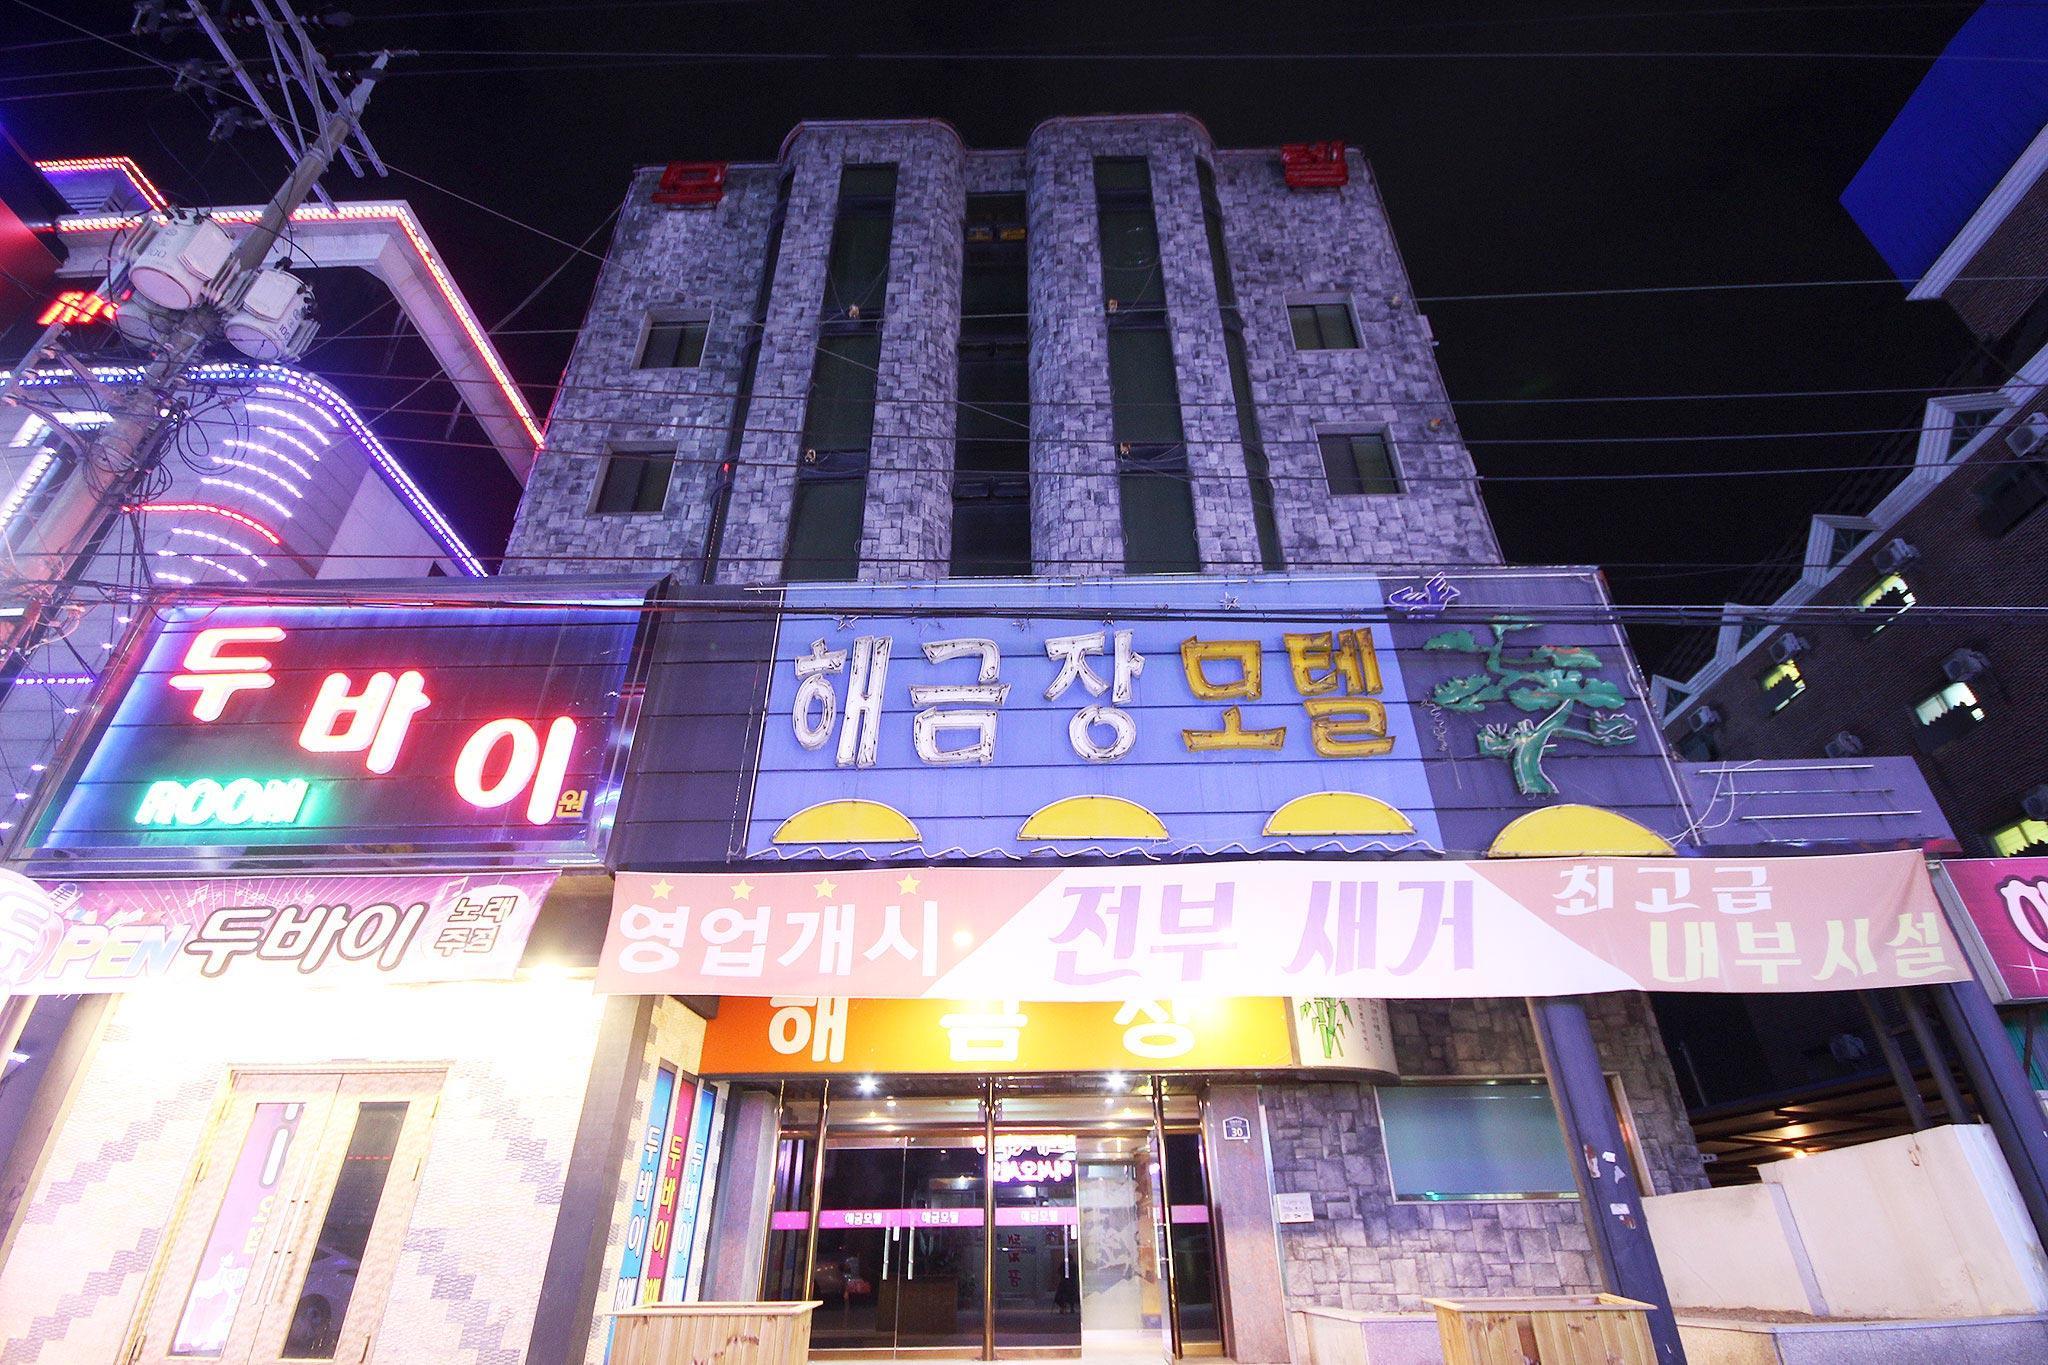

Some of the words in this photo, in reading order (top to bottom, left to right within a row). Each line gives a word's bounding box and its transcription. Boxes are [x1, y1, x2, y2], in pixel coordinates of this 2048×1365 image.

[168, 625, 577, 826] 두바이
[134, 778, 310, 826] ROOM
[447, 895, 519, 923] 노래
[1551, 864, 1773, 916] 최고급
[184, 902, 430, 978] 두바이
[1048, 882, 1237, 986] 전부
[1282, 880, 1475, 976] 새거
[1231, 1127, 1243, 1137] 30
[628, 1126, 662, 1259] 두바이
[653, 1135, 684, 1260] 두바이
